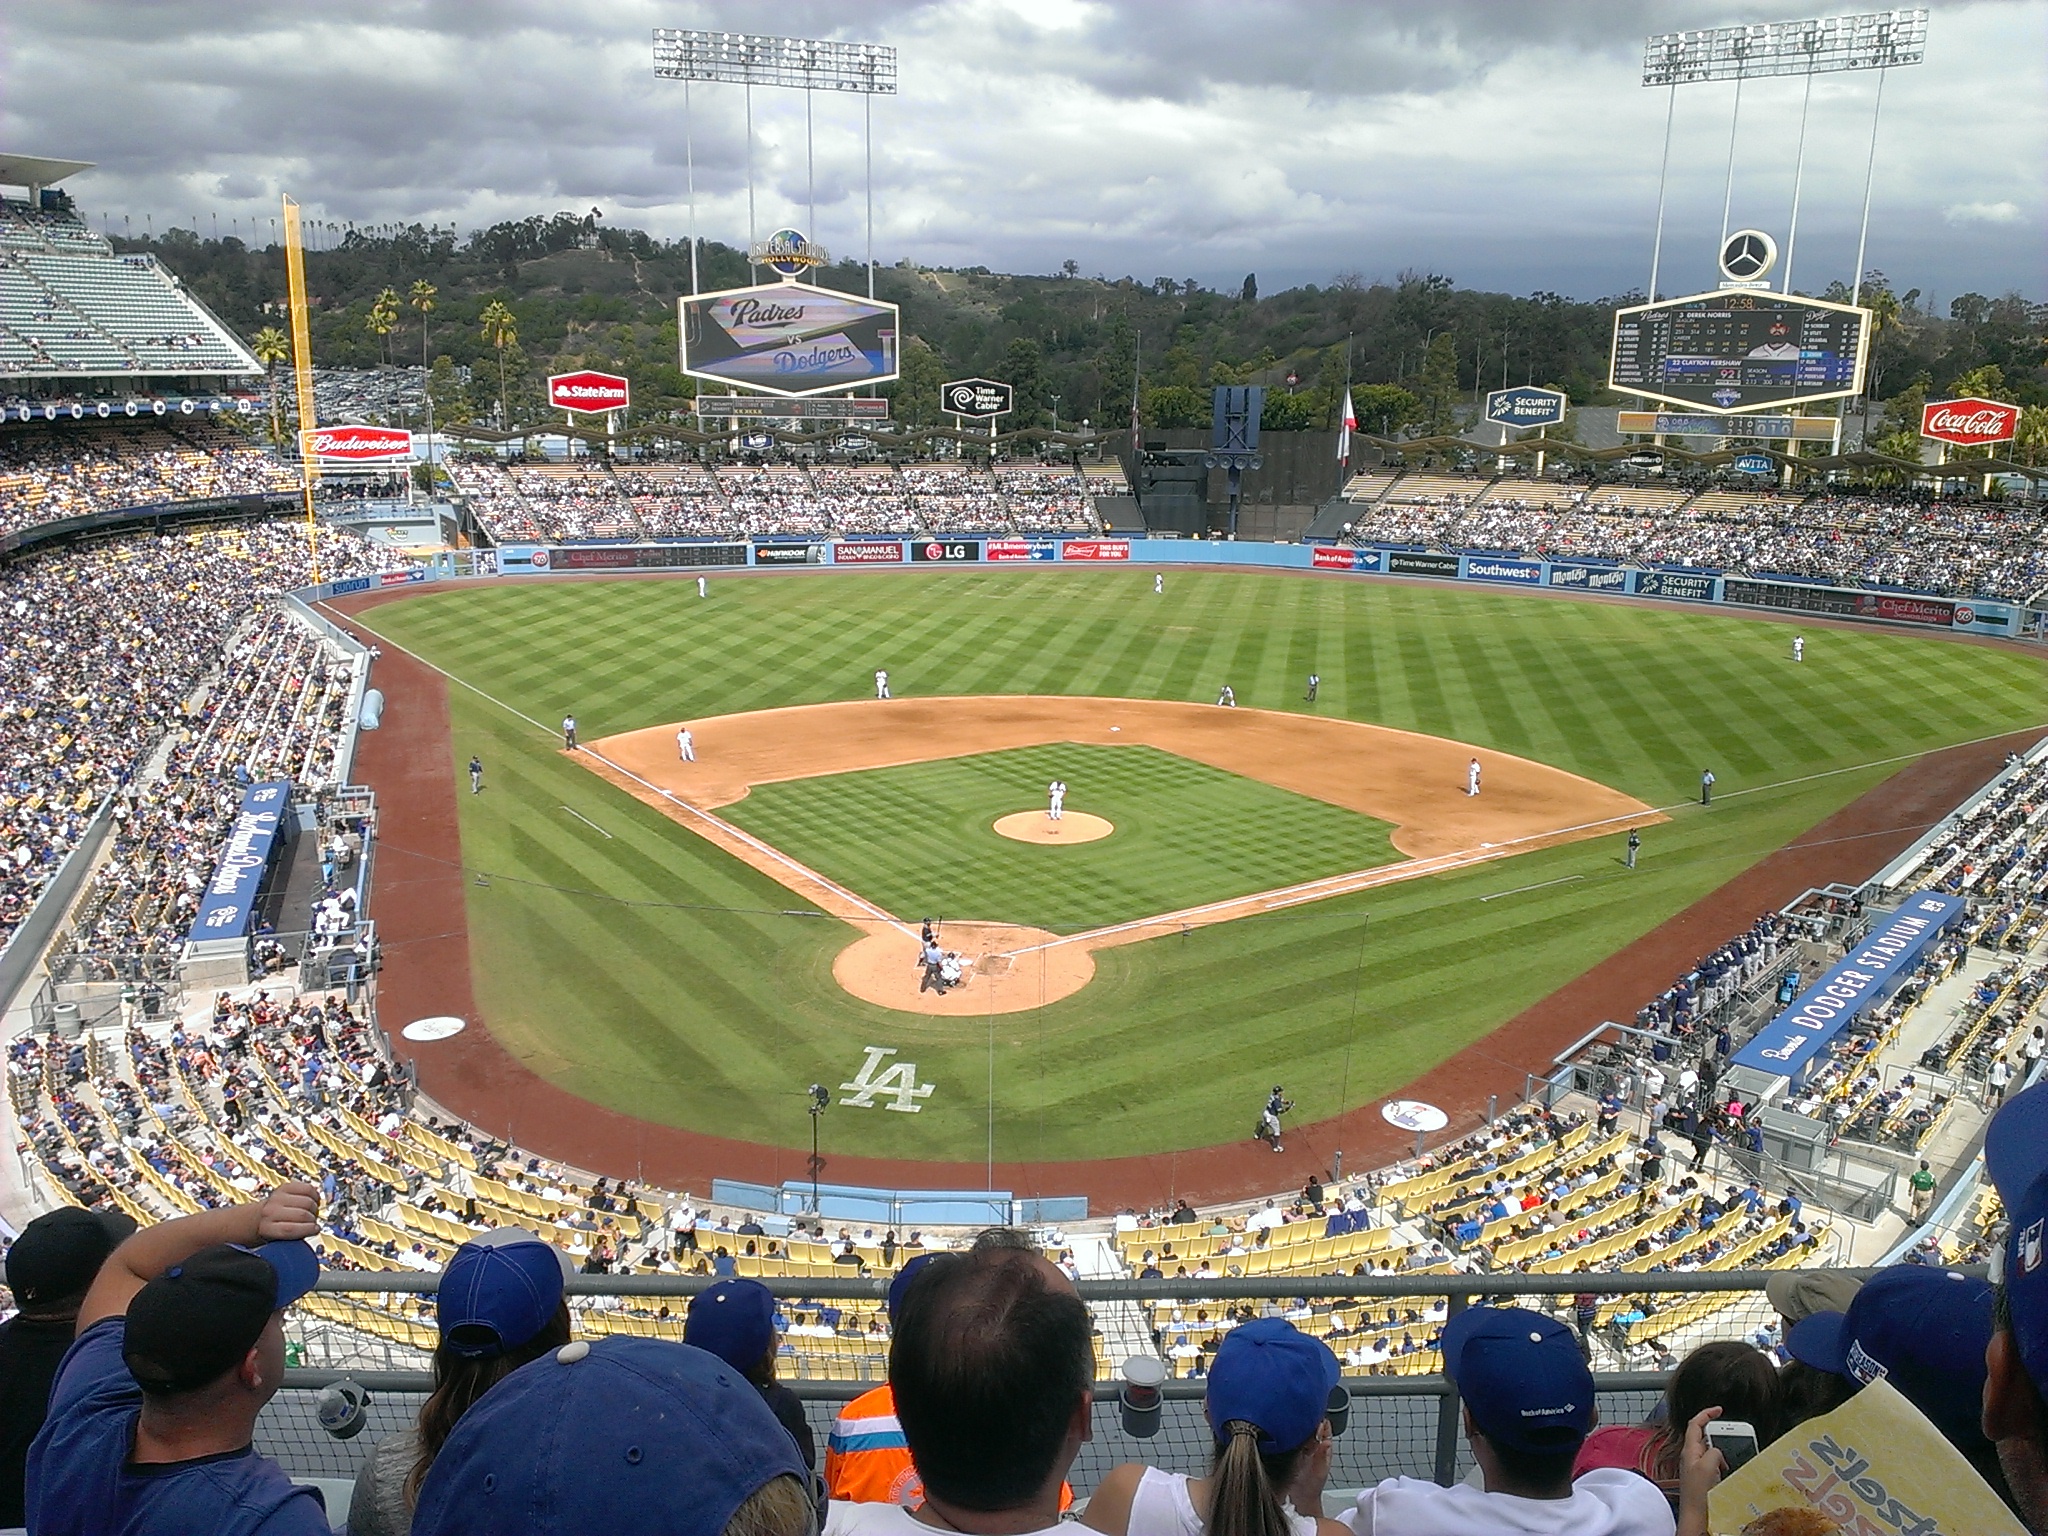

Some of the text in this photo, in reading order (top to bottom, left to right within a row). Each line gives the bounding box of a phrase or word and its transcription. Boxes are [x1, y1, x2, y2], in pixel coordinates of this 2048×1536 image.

[751, 240, 828, 260] UNIVERSAL STUDIOS
[761, 255, 819, 265] HOLLYWOOD
[1724, 298, 1754, 309] 12:58
[730, 299, 805, 329] Padres
[773, 346, 856, 374] Dodgers
[1720, 370, 1735, 379] 92
[975, 387, 996, 395] Time
[975, 394, 1004, 403] Warner
[1515, 397, 1558, 407] SECURITY
[975, 402, 998, 410] Cable
[1514, 407, 1553, 416] BENEFIT
[1929, 409, 2009, 435] Coca-Cola
[305, 434, 409, 453] Budweiser
[1739, 458, 1768, 470] AVITA
[838, 546, 899, 555] SAN MANUEL
[945, 545, 965, 559] LG
[572, 553, 595, 563] Chef
[598, 552, 629, 561] Merito
[1314, 553, 1331, 562] Bank
[1337, 554, 1363, 564] America
[1413, 560, 1438, 568] Warner
[1438, 562, 1456, 570] Cable
[1468, 562, 1531, 578] Southwest
[1662, 575, 1710, 588] SECURITY
[1661, 586, 1703, 597] BENEFIT
[1882, 600, 1950, 616] Chef Merito
[1957, 610, 1972, 621] 76
[1792, 915, 1931, 1031] DODGER STADIUM
[839, 1046, 936, 1113] LA
[1541, 1406, 1565, 1416] America
